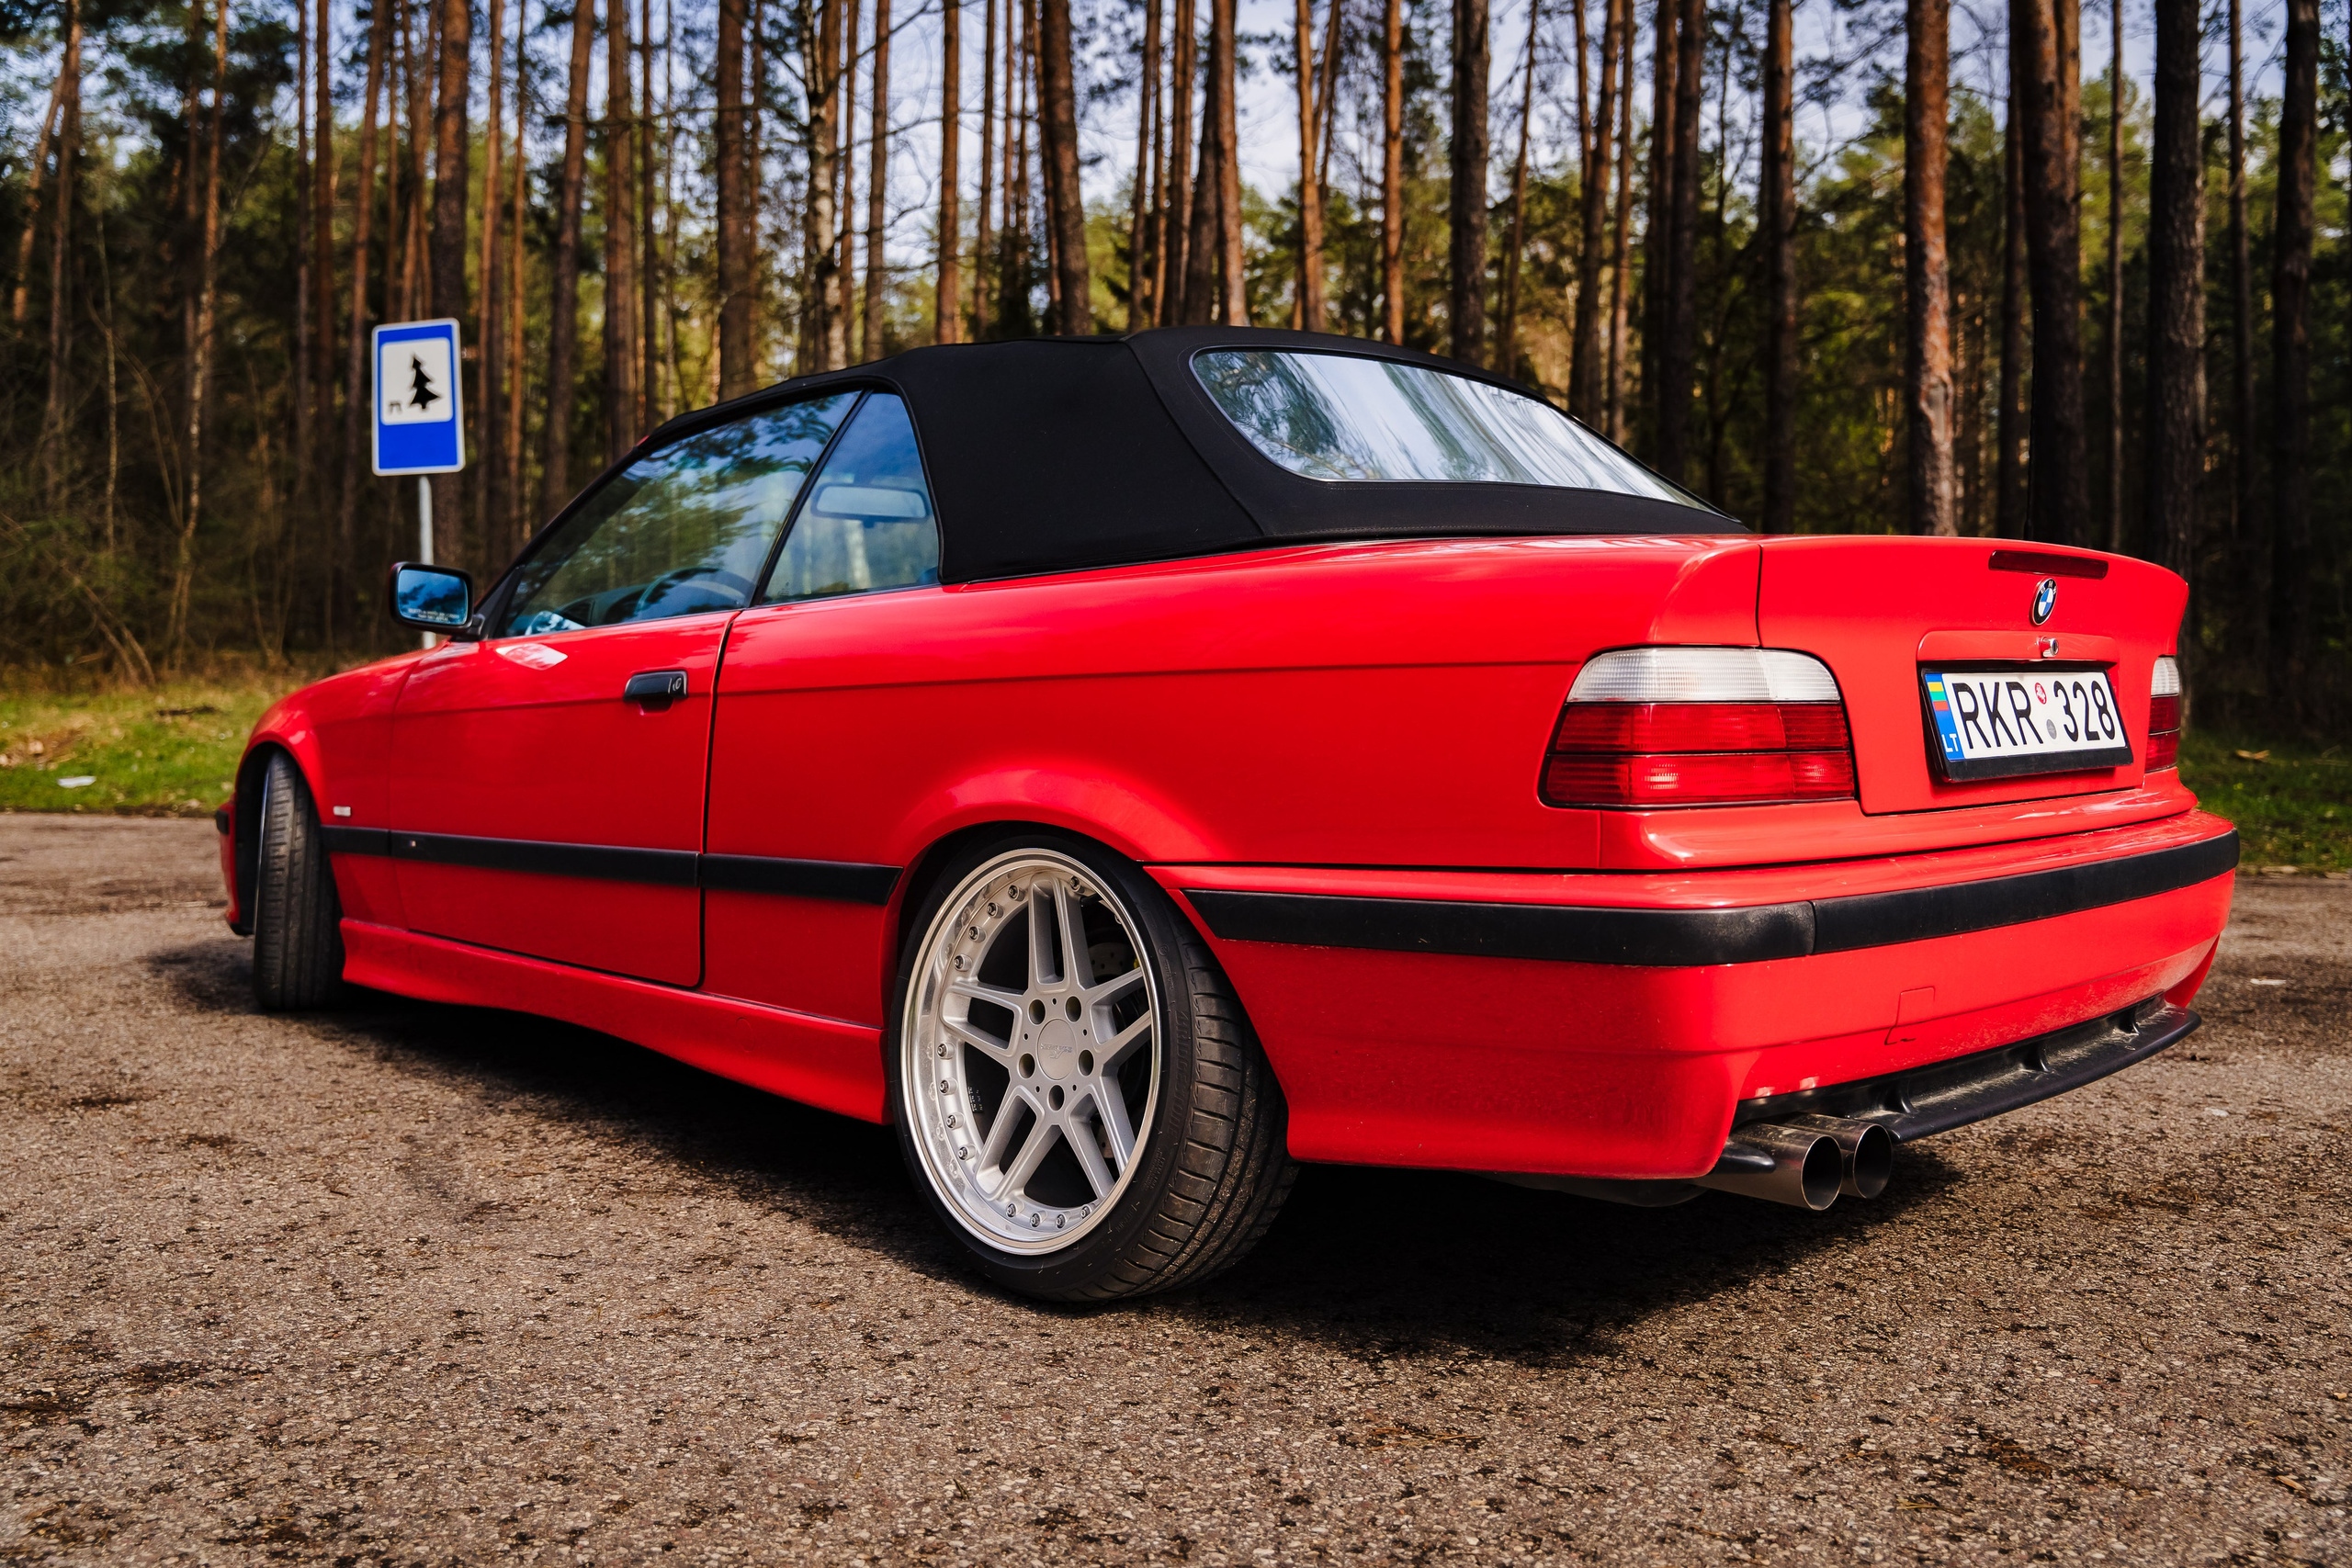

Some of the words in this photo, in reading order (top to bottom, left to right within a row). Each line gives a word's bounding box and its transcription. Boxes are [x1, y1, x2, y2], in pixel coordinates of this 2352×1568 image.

[2040, 580, 2057, 595] BMW
[1951, 682, 2044, 750] RKR
[2052, 680, 2116, 742] 328
[1941, 733, 1960, 753] LT
[1167, 1010, 1190, 1139] BRIDGESTONE
